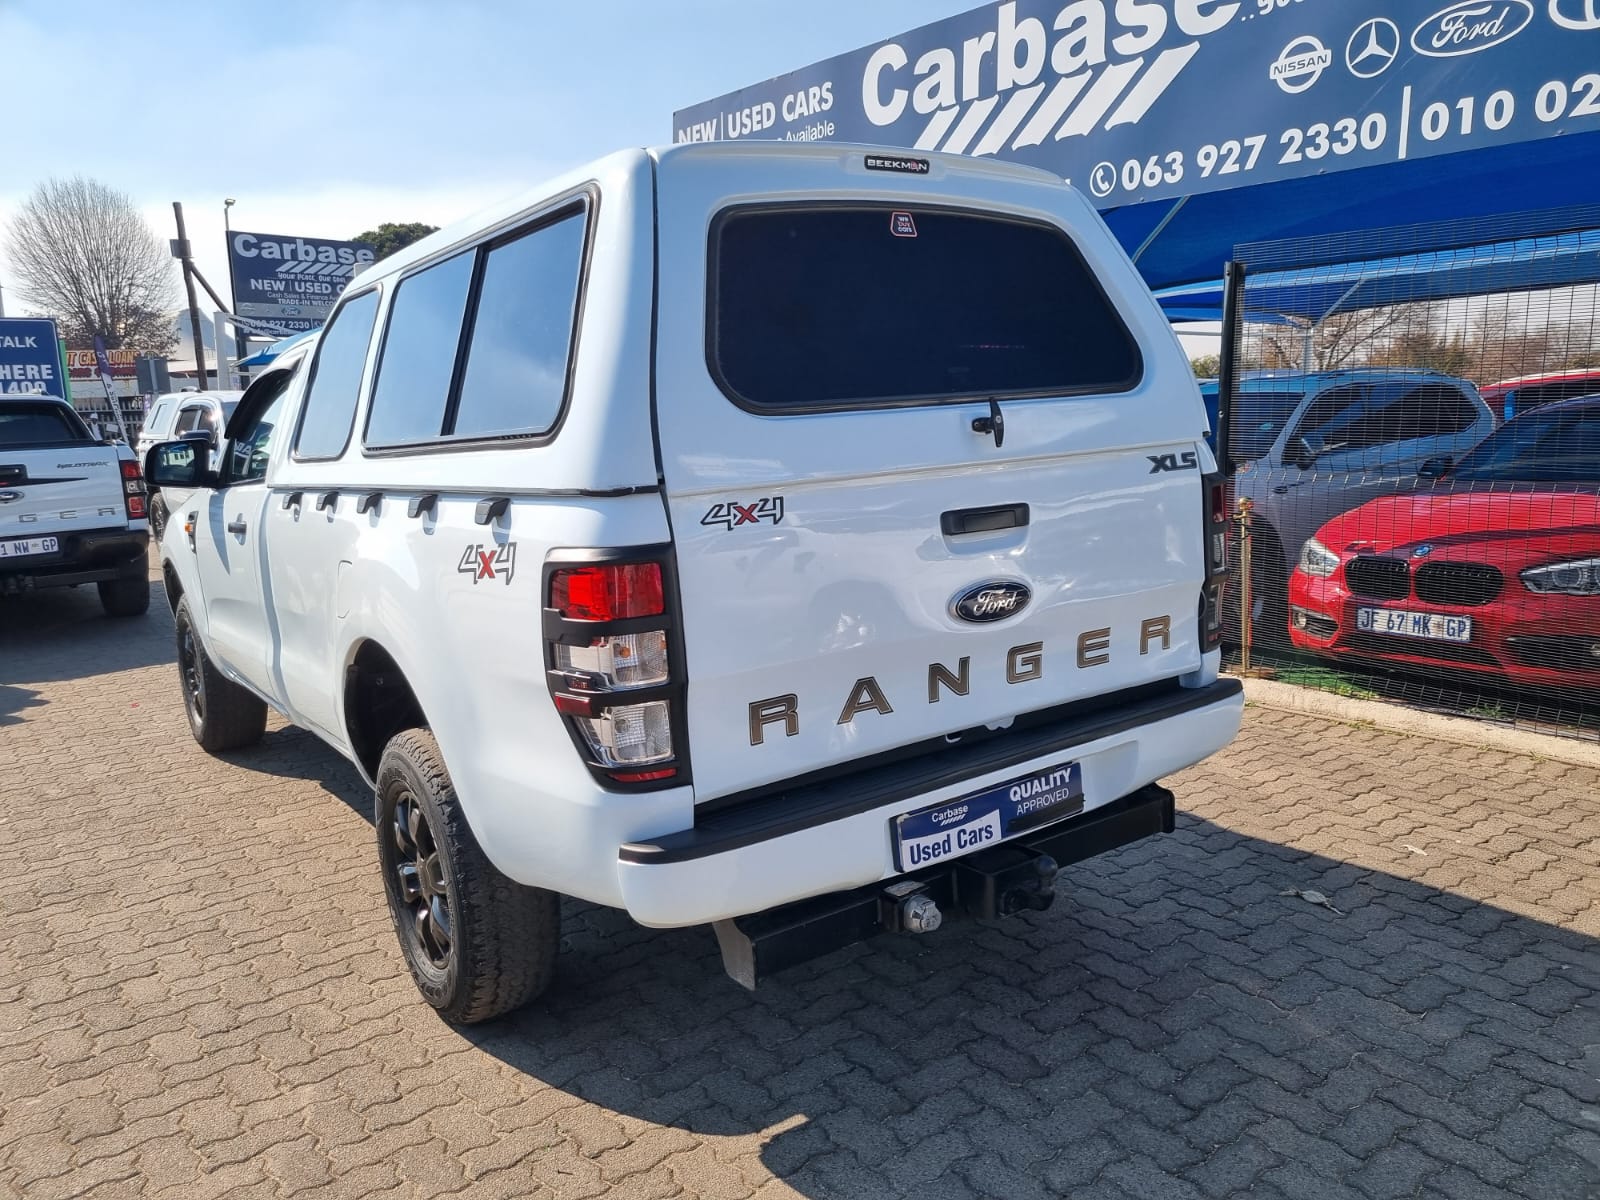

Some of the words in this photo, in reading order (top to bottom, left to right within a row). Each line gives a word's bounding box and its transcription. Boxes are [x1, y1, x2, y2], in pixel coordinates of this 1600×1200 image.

[1431, 5, 1511, 48] Ford
[1273, 54, 1328, 75] NISSAN
[678, 118, 717, 144] NEW
[728, 102, 776, 138] USED
[782, 81, 834, 122] CARS
[786, 120, 835, 141] Available
[1121, 151, 1184, 191] 063
[1196, 134, 1267, 178] 927
[1278, 112, 1388, 165] 2330
[1421, 90, 1515, 141] 010
[1535, 73, 1600, 122] 02
[867, 159, 928, 171] BEEKMAN
[234, 234, 375, 264] Carbase
[251, 279, 285, 291] NEW
[295, 281, 331, 293] USED
[278, 298, 310, 306] TRADE-IN
[1145, 451, 1198, 475] XLS
[14, 541, 30, 554] NW
[41, 538, 57, 551] GP
[973, 588, 1018, 617] Ford
[1387, 613, 1406, 631] 67
[1446, 618, 1467, 638] GP
[749, 615, 1171, 746] RANGER
[931, 805, 969, 823] Carbase
[1009, 767, 1072, 802] QUALITY
[1016, 787, 1070, 817] APPROVED
[910, 833, 952, 865] Used
[957, 824, 994, 849] Cars
